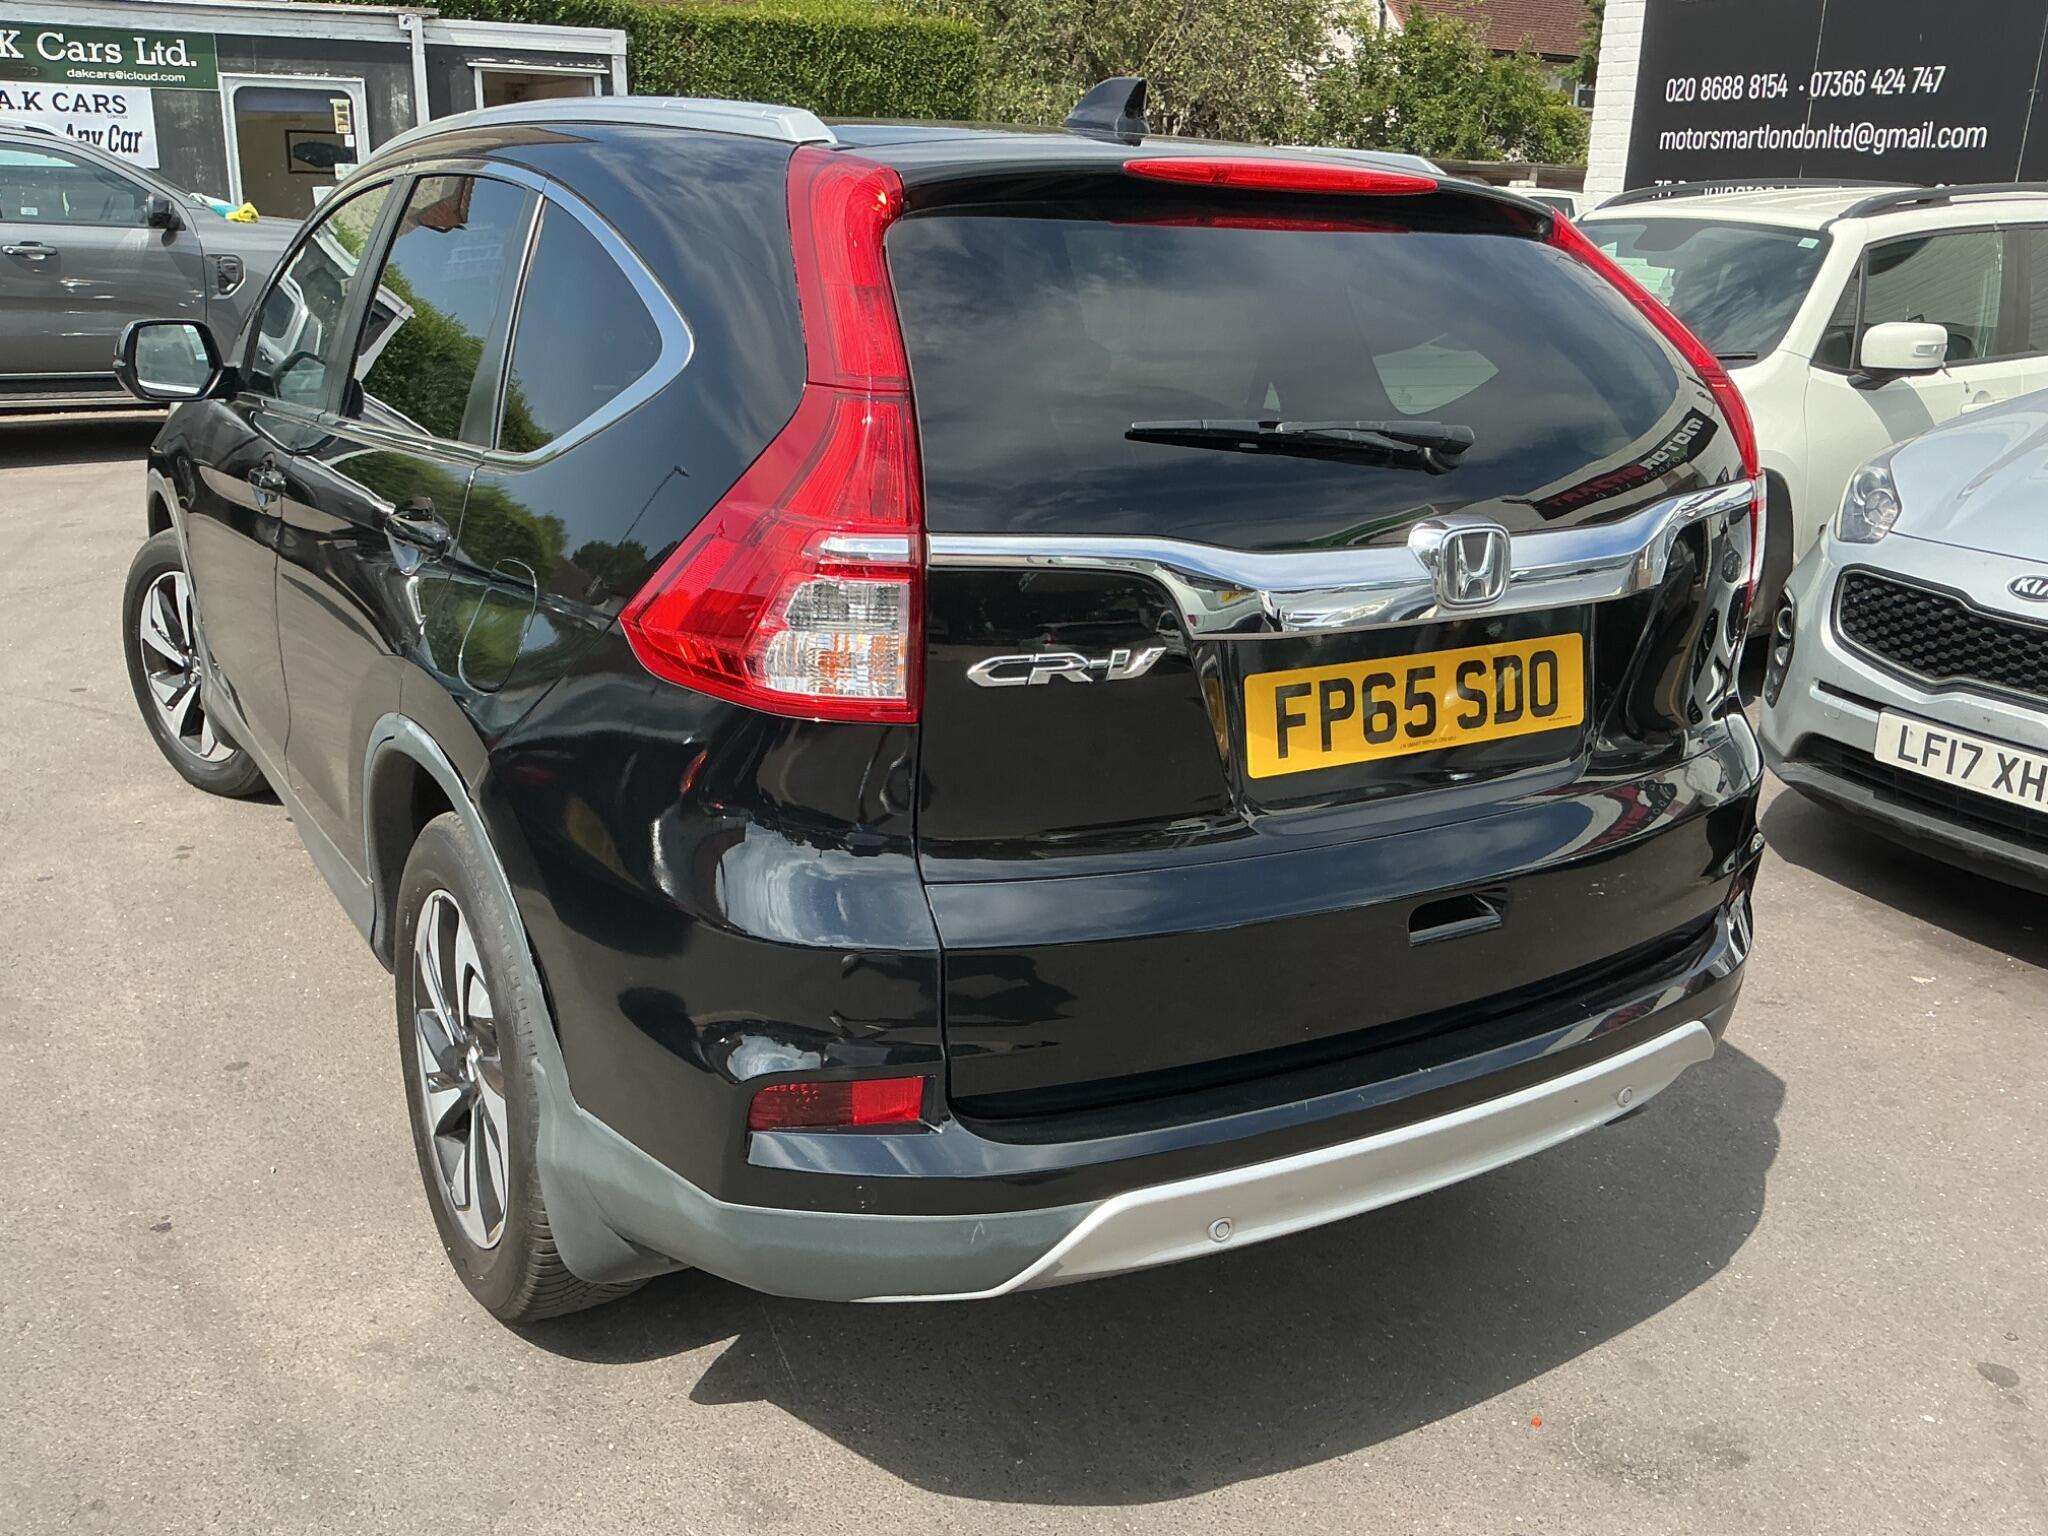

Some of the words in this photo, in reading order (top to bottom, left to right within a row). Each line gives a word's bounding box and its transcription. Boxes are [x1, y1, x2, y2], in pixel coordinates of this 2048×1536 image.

[0, 29, 24, 59] K
[36, 31, 123, 64] Cars
[133, 37, 197, 67] Ltd.
[66, 68, 186, 82] dakcars@icloud.com
[1665, 77, 1696, 102] 020
[1701, 75, 1744, 101] 8688
[1748, 73, 1788, 99] 8154
[1810, 69, 1866, 97] 07366
[1871, 67, 1906, 95] 424
[1911, 66, 1946, 94] 747
[52, 92, 127, 114] CARS
[108, 124, 142, 153] Car
[1659, 121, 1987, 155] motorsmartlondonltd@gmail.com
[966, 646, 1167, 688] CR-V
[1274, 665, 1438, 760] FP65
[1455, 649, 1559, 731] SDO
[1897, 724, 1984, 779] LF17
